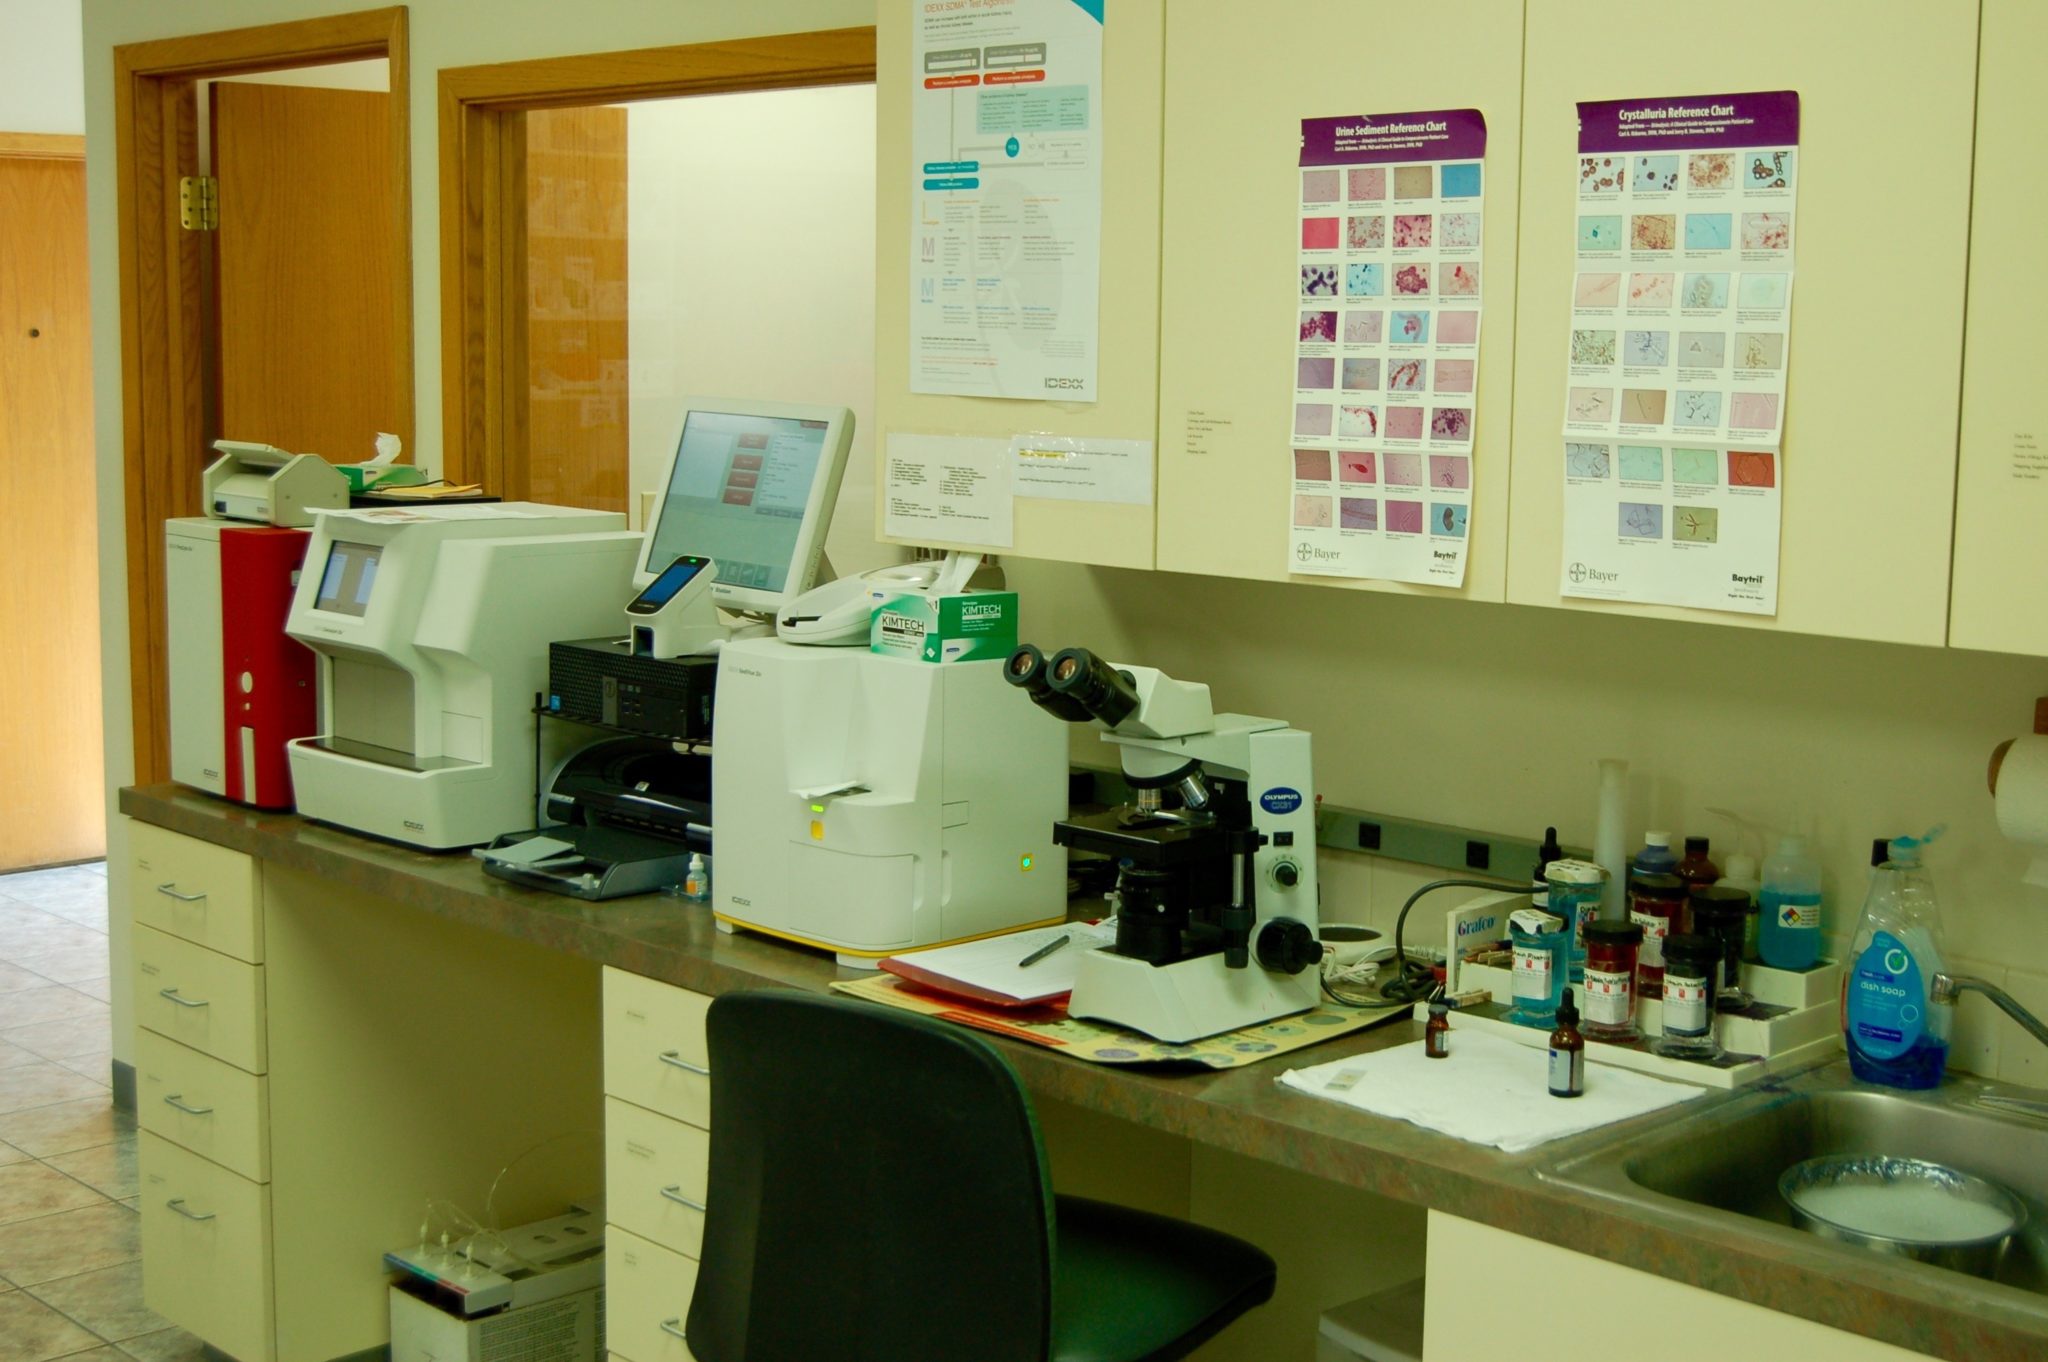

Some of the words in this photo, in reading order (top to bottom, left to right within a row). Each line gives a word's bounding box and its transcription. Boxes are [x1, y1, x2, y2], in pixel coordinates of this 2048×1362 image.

[1619, 108, 1666, 122] Crystalluria
[1668, 107, 1710, 118] Reference
[1711, 105, 1734, 116] Chart
[1336, 127, 1354, 136] Urine
[1355, 124, 1389, 135] Sediment
[1390, 123, 1425, 133] Reference
[1426, 121, 1446, 131] Chart
[922, 237, 935, 256] M
[922, 278, 934, 296] M
[1044, 378, 1084, 390] IDEXX
[1314, 548, 1340, 561] Bayer
[1434, 551, 1457, 560] Baytril
[1589, 568, 1618, 583] Bayer
[1732, 574, 1762, 584] Baytril
[962, 605, 1001, 615] KIMTECH
[882, 616, 924, 631] KIMTECH
[1457, 915, 1495, 936] Grafco
[1861, 980, 1879, 991] dish
[1881, 986, 1906, 997] soap
